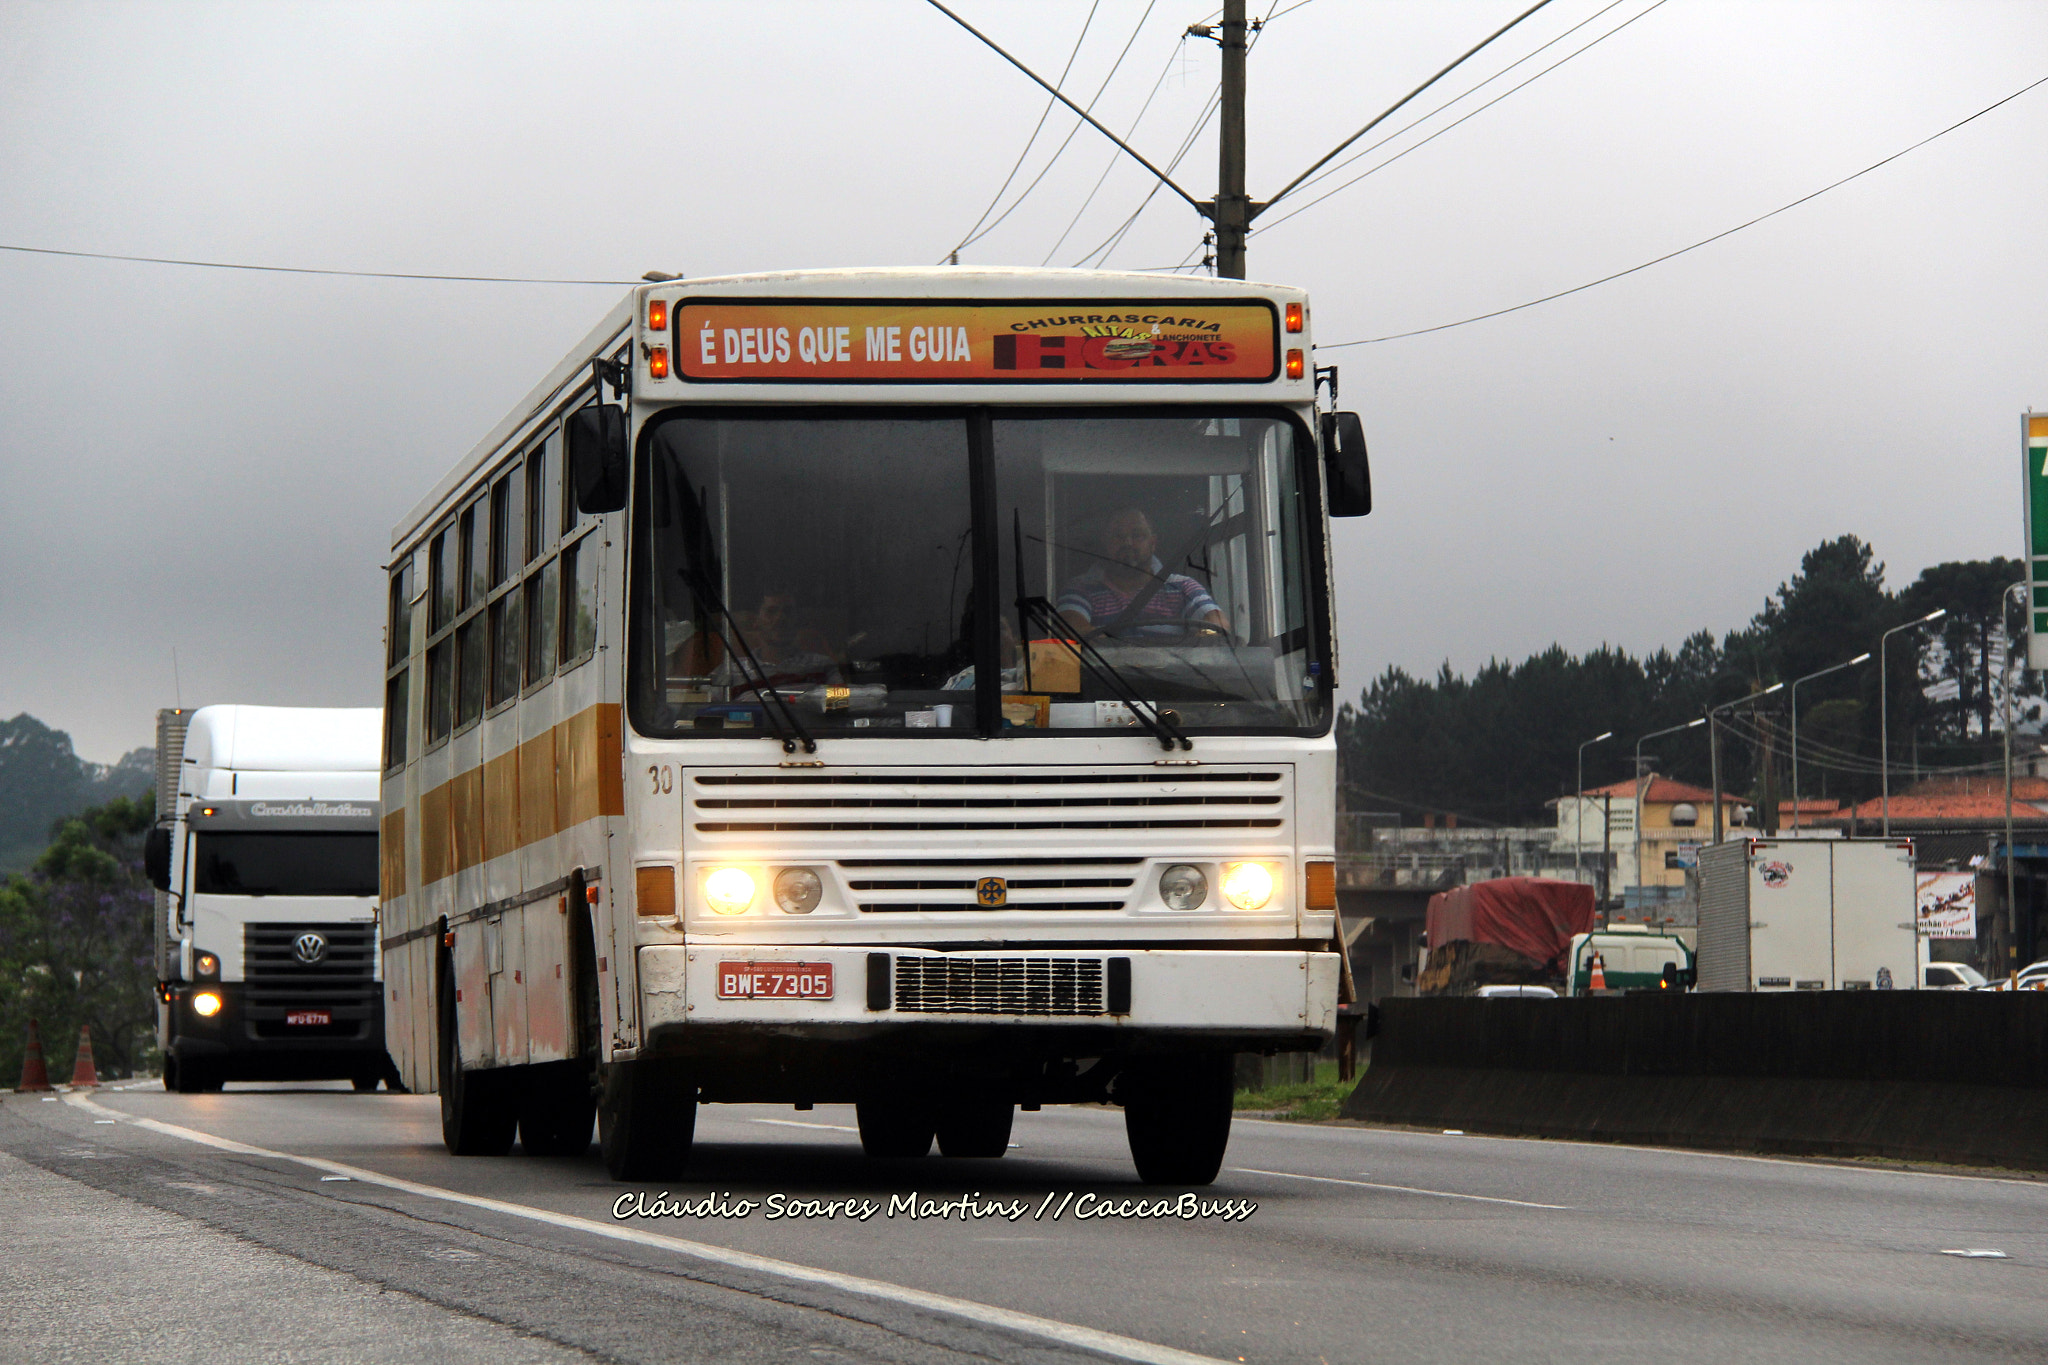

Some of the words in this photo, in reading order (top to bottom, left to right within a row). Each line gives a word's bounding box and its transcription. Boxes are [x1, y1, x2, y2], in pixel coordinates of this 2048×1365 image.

[1010, 314, 1221, 332] CHURRASCARIA
[1151, 323, 1161, 335] &
[1157, 334, 1222, 342] LANCHONETE
[700, 320, 716, 364] É
[724, 328, 790, 363] DEUS
[799, 327, 850, 365] QUE
[866, 327, 901, 361] ME
[909, 326, 971, 361] GUIA
[993, 334, 1237, 370] HORAS
[649, 765, 672, 795] 30
[251, 803, 372, 816] Constellation
